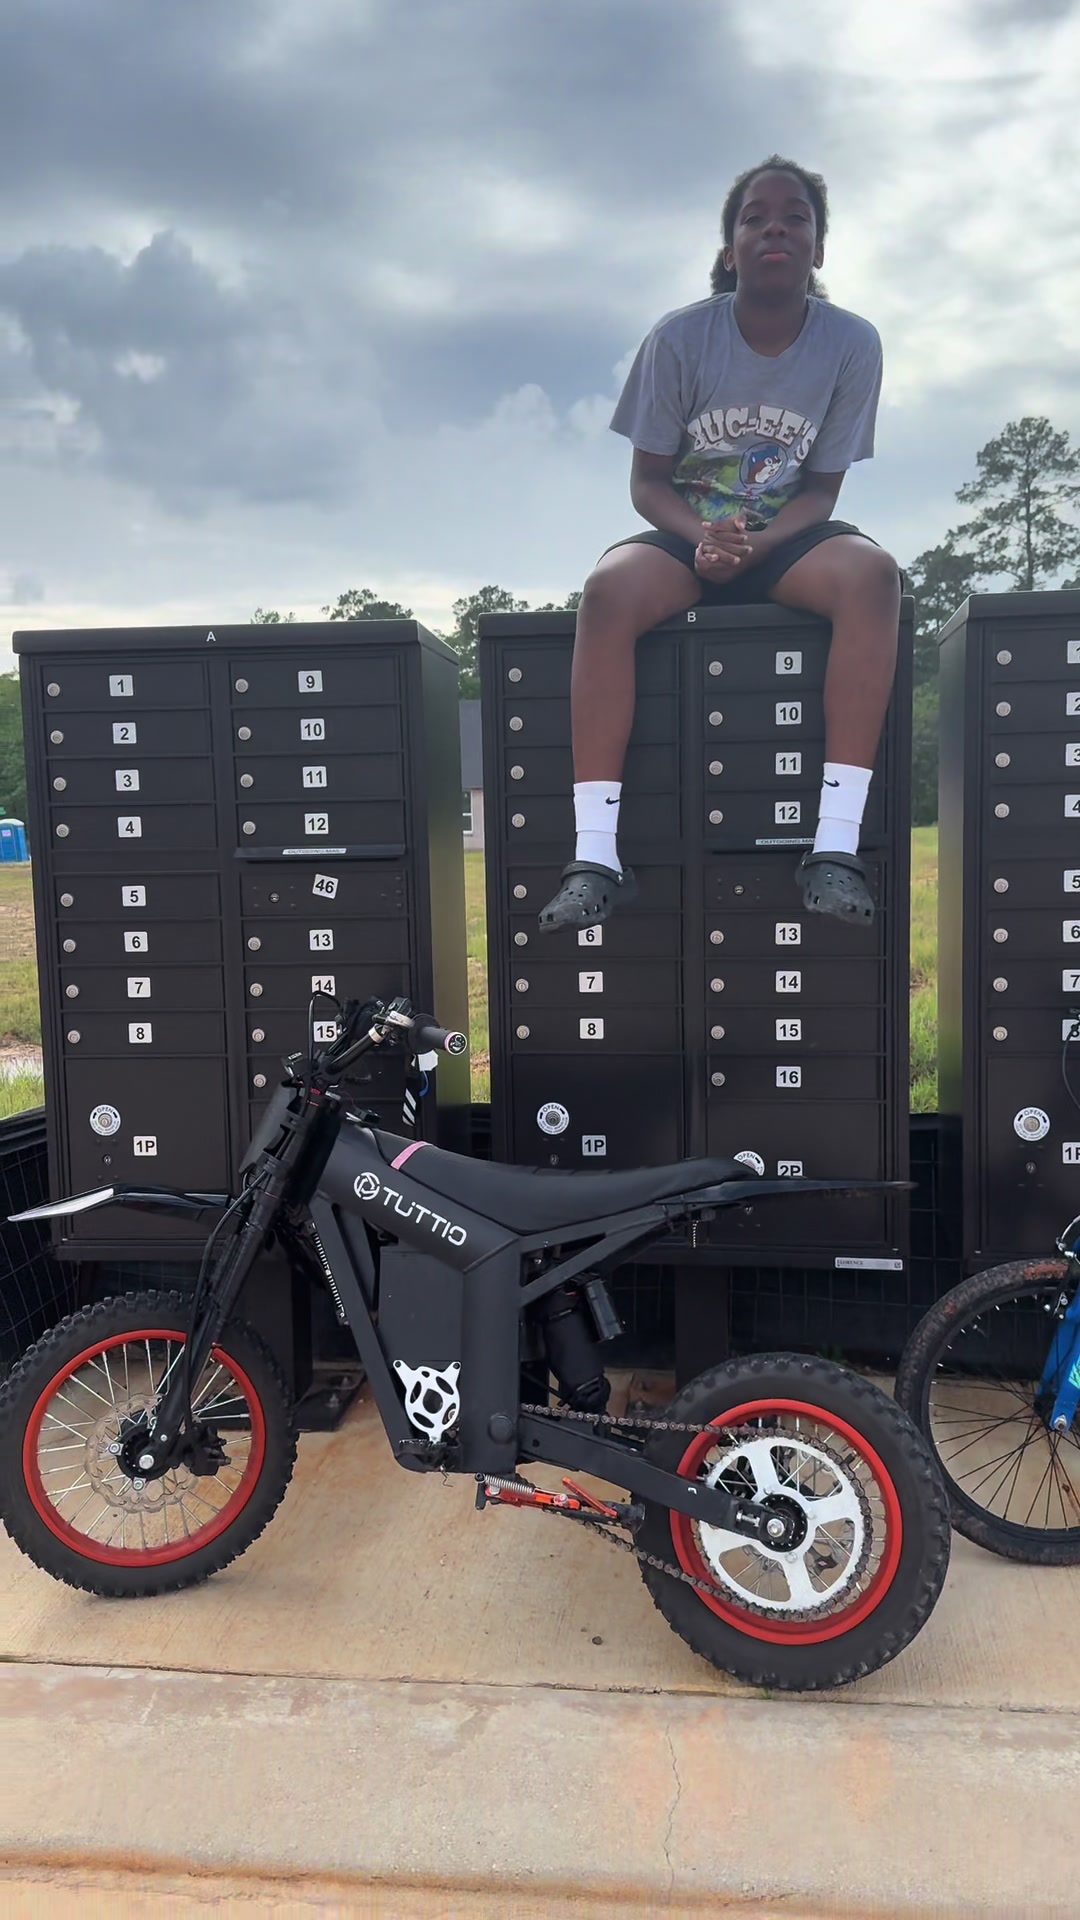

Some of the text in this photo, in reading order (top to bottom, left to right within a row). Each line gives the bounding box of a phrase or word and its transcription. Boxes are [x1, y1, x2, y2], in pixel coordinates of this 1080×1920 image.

[687, 611, 697, 623] B
[206, 631, 217, 642] A
[783, 655, 794, 671] 9
[117, 678, 125, 693] 1
[305, 674, 316, 689] 9
[779, 706, 799, 722] 10
[119, 727, 130, 741] 2
[304, 722, 323, 737] 10
[779, 756, 797, 771] 11
[123, 774, 133, 788] 3
[306, 770, 323, 784] 11
[778, 805, 798, 820] 12
[1071, 799, 1080, 814] 4
[125, 820, 135, 834] 4
[308, 817, 327, 831] 12
[314, 878, 335, 894] 46
[1071, 874, 1080, 889] 5
[130, 889, 139, 904] 5
[585, 928, 595, 943] 6
[778, 927, 798, 942] 13
[1070, 924, 1080, 939] 6
[131, 935, 141, 949] 6
[312, 933, 331, 947] 13
[134, 981, 144, 995] 7
[314, 979, 334, 993] 14
[586, 975, 596, 990] 7
[779, 975, 799, 989] 14
[1070, 974, 1080, 989] 7
[136, 1027, 145, 1041] 8
[316, 1025, 335, 1039] 15
[587, 1022, 597, 1036] 8
[779, 1023, 799, 1038] 15
[779, 1070, 799, 1085] 16
[543, 1104, 561, 1112] OPEN
[1023, 1109, 1043, 1117] OPEN
[136, 1140, 155, 1153] 1P
[584, 1138, 605, 1153] 1P
[737, 1152, 756, 1161] OPEN
[780, 1164, 801, 1176] 2P
[382, 1186, 468, 1246] TUTTIO
